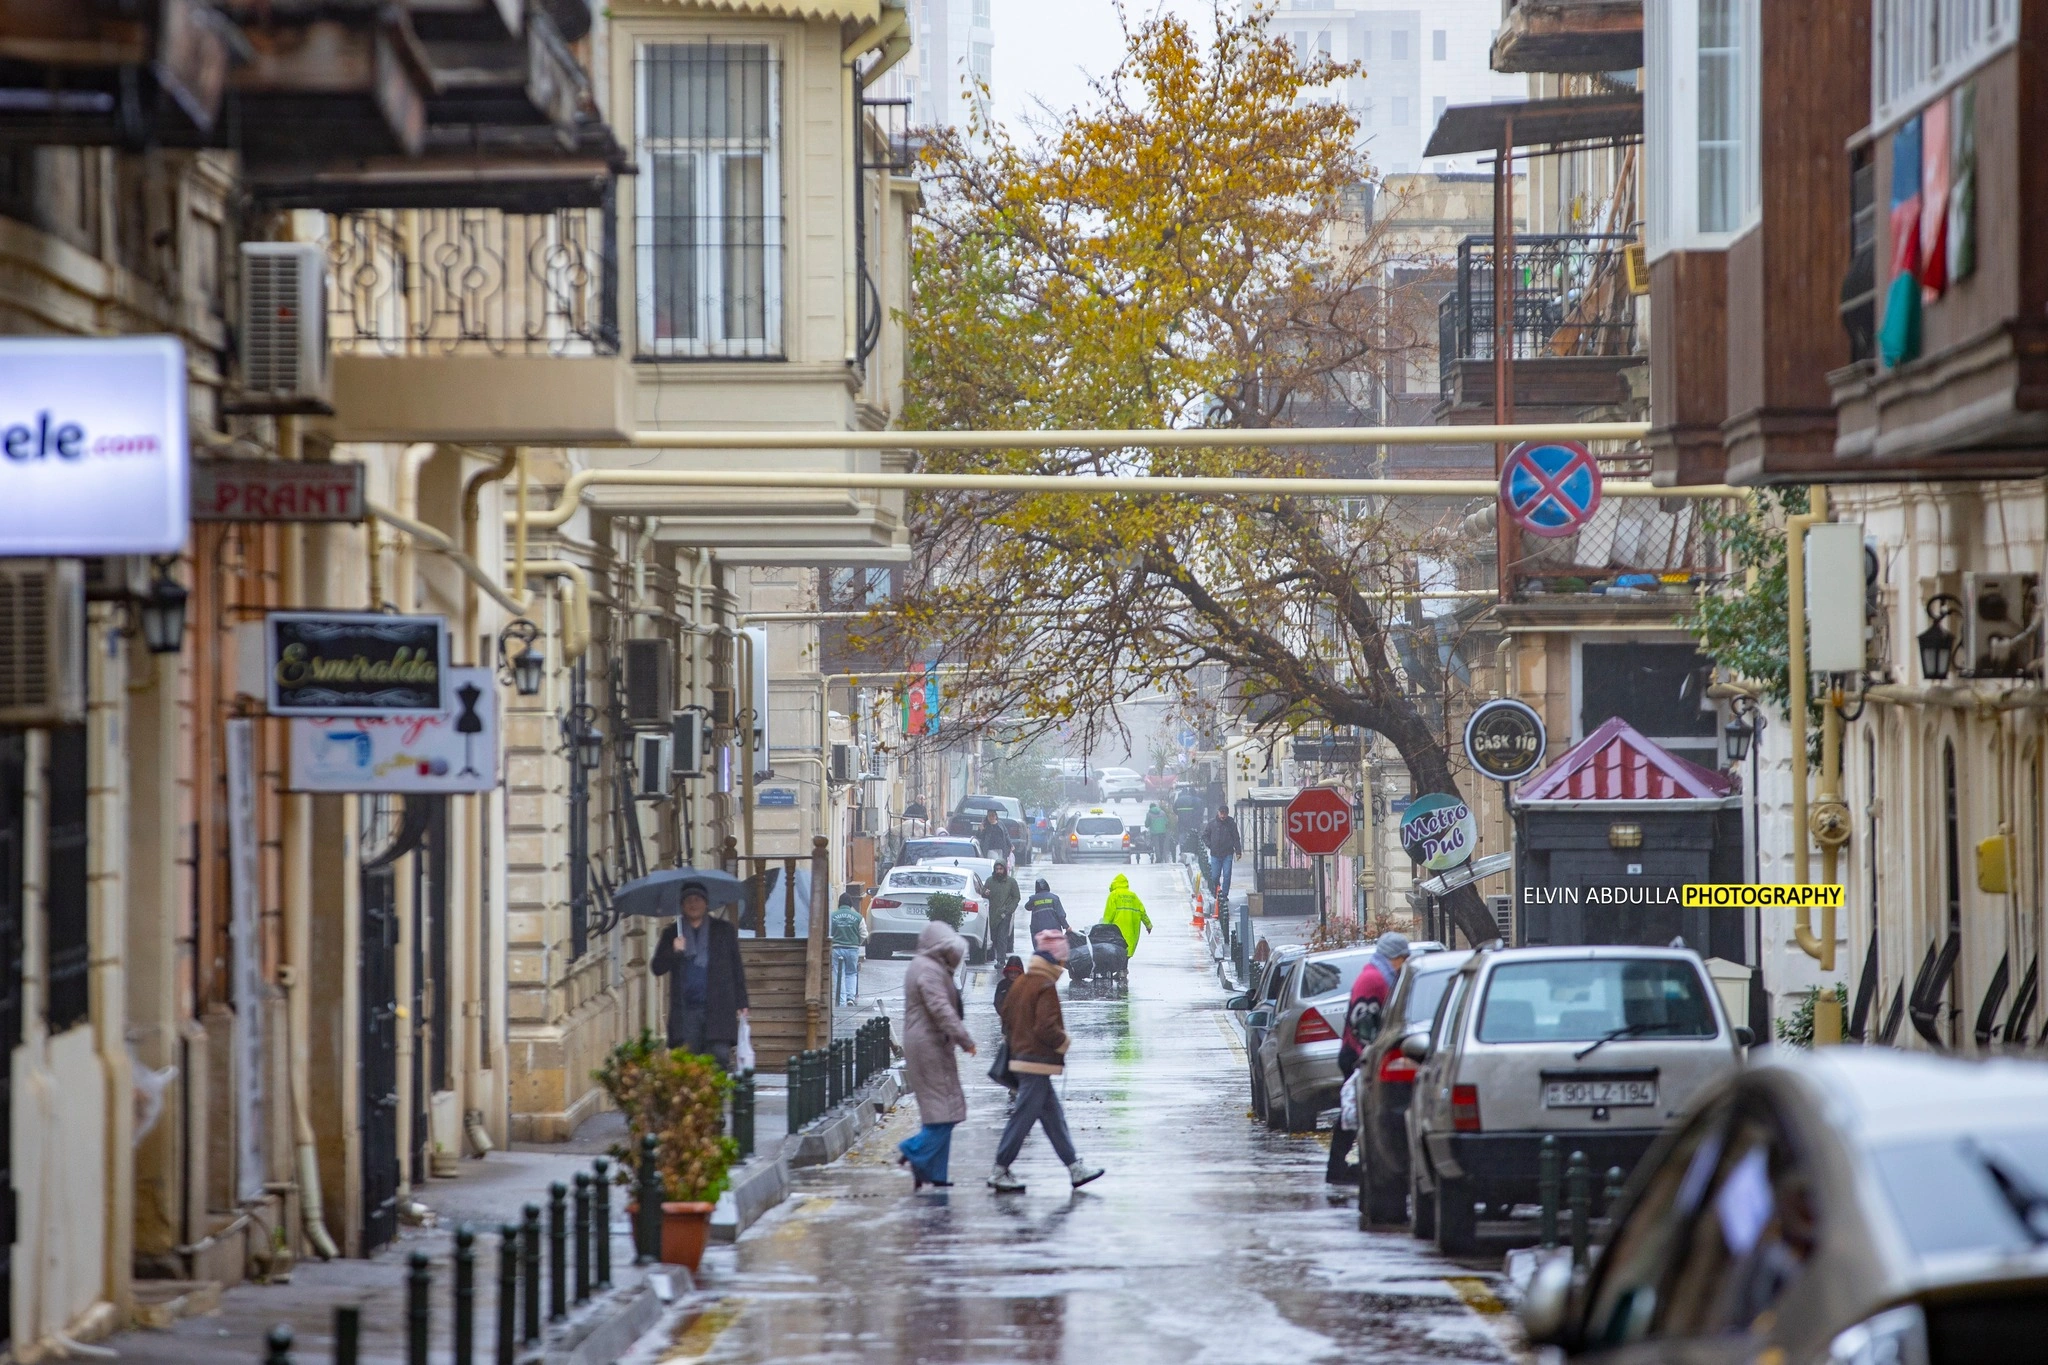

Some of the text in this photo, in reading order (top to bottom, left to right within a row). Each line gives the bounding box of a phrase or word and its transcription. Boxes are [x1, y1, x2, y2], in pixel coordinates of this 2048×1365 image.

[275, 643, 438, 688] Esmiralda
[1474, 734, 1537, 751] CASK 110
[1289, 809, 1348, 834] STOP
[1403, 803, 1469, 847] Metro
[1422, 827, 1465, 861] Pub
